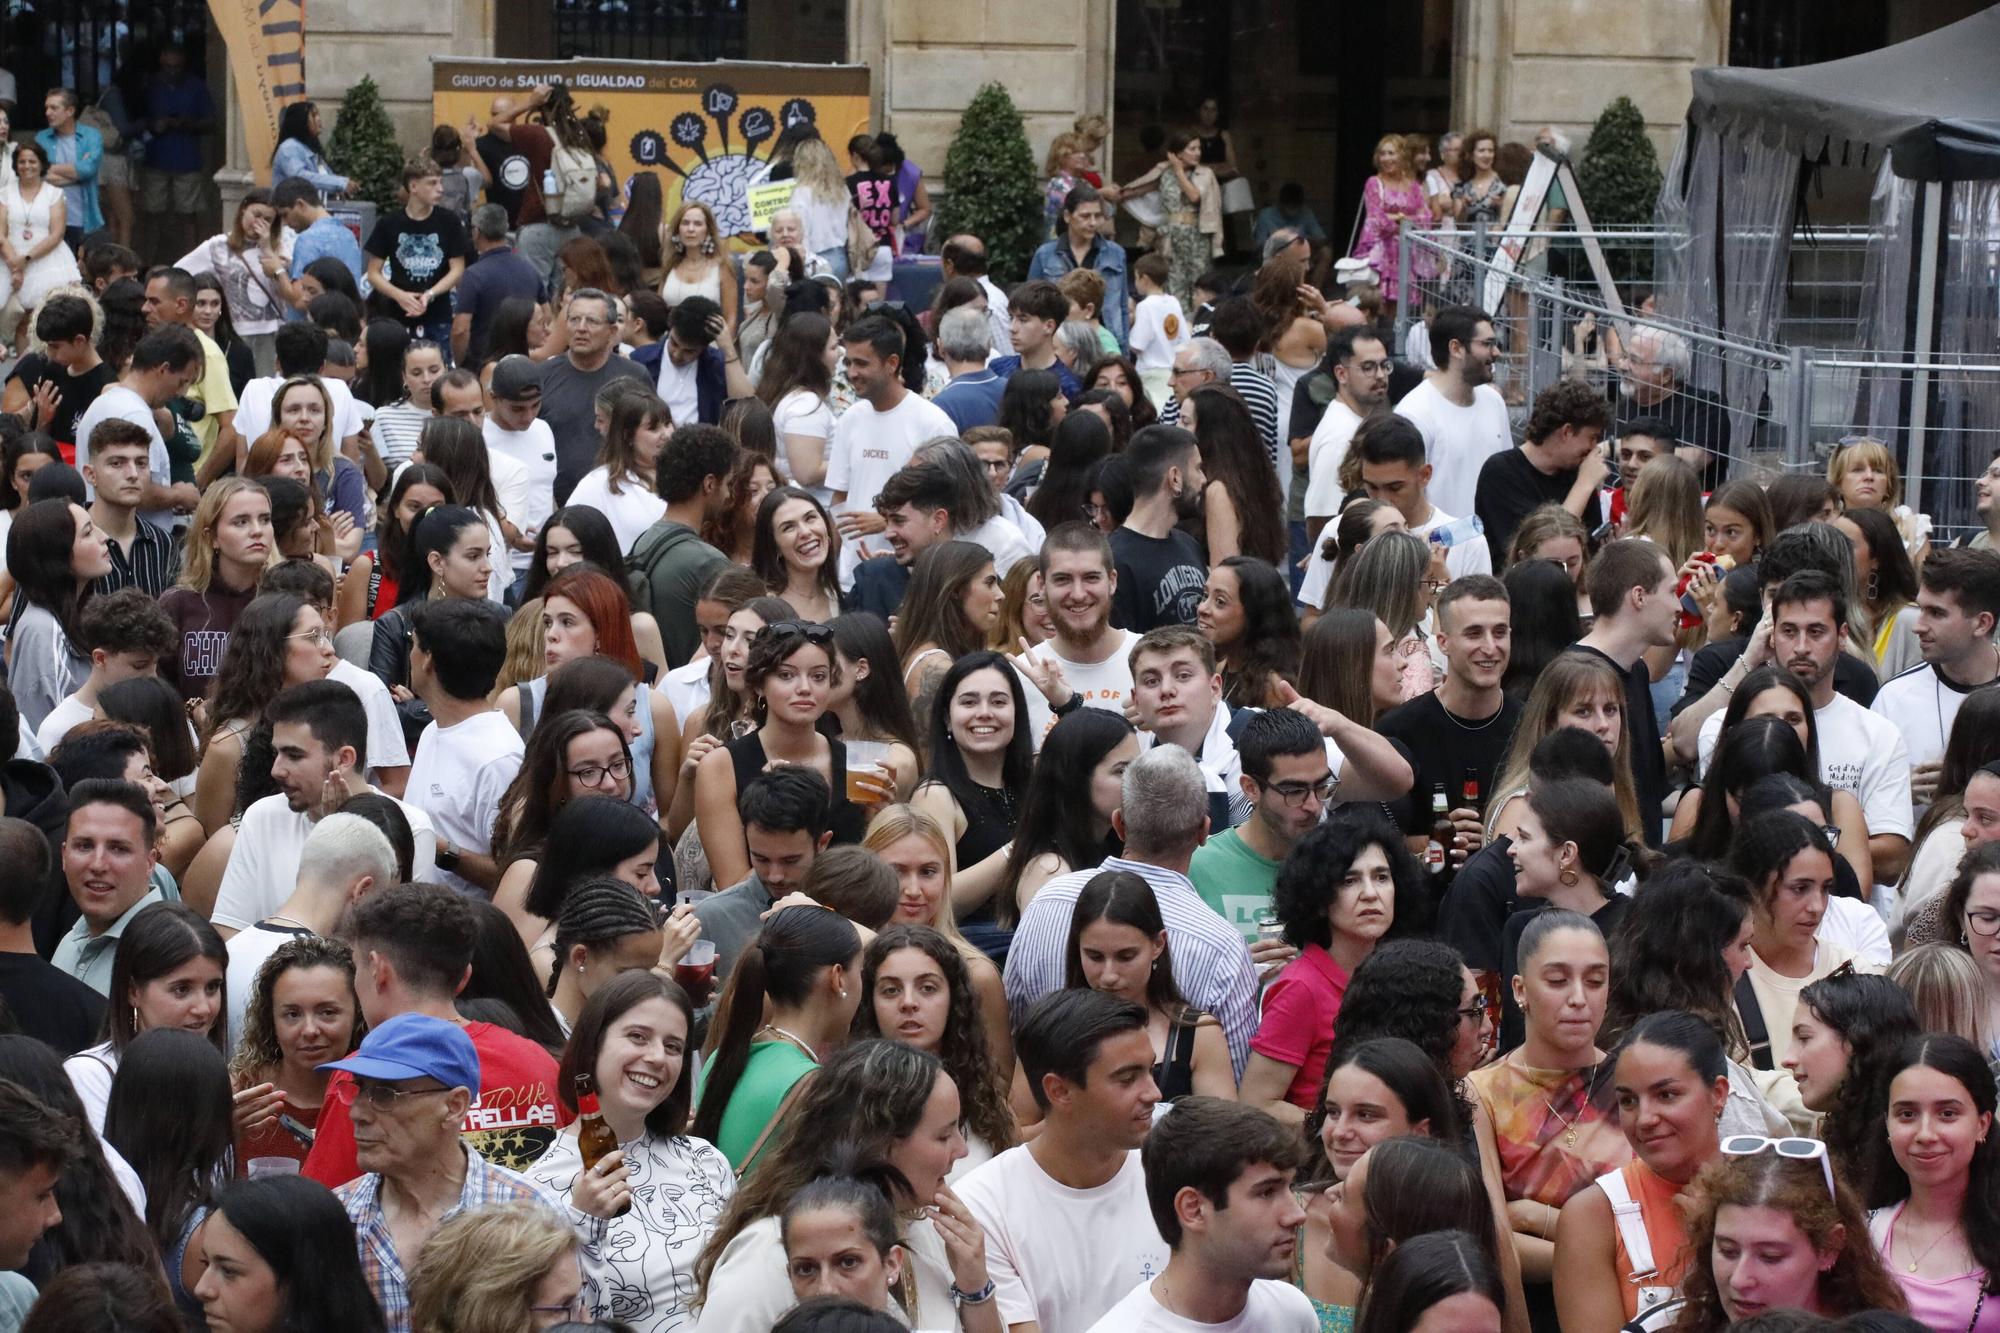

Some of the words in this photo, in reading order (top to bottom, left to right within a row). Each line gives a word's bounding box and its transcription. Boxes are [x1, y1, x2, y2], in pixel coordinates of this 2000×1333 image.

[452, 75, 497, 87] GRUPO
[499, 77, 513, 87] de
[576, 74, 645, 88] IGUALDAD
[669, 77, 697, 88] CMX
[857, 180, 891, 208] EX
[753, 206, 781, 217] ALCO
[368, 573, 381, 608] BIMBA
[183, 631, 230, 676] CHI
[481, 1081, 549, 1111] TOUR
